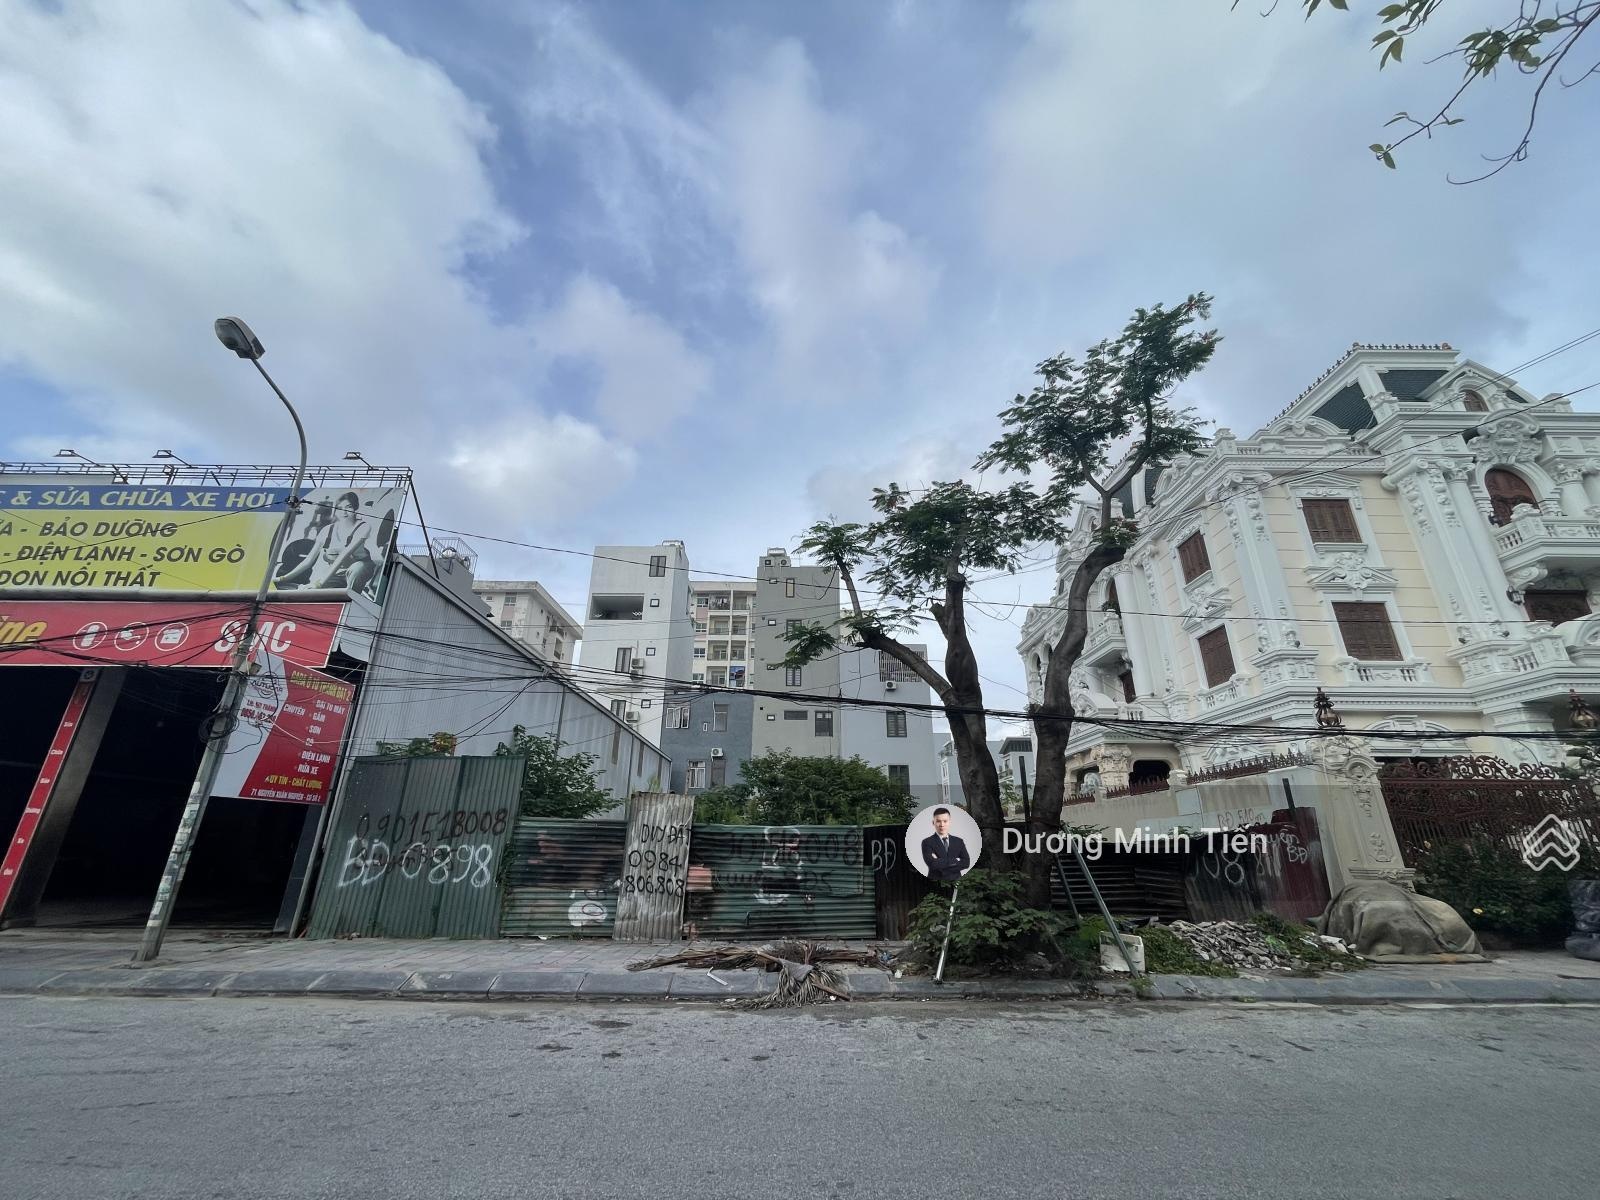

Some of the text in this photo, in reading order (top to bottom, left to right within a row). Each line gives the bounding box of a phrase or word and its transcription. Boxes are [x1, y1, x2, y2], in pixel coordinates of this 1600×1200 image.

[10, 490, 32, 505] &
[37, 486, 91, 506] SỬA
[100, 487, 174, 507] CHỮA
[181, 491, 217, 507] XE
[225, 490, 275, 508] HƠI
[39, 516, 89, 537] BẢO
[92, 518, 178, 538] DƯỠNG
[16, 541, 70, 566] ĐIỆN
[73, 545, 136, 566] LẠNH
[153, 545, 204, 563] SƠN
[208, 542, 246, 563] GÒ
[104, 564, 161, 587] THẤT
[628, 850, 683, 877] 0984
[625, 875, 686, 898] 806.808
